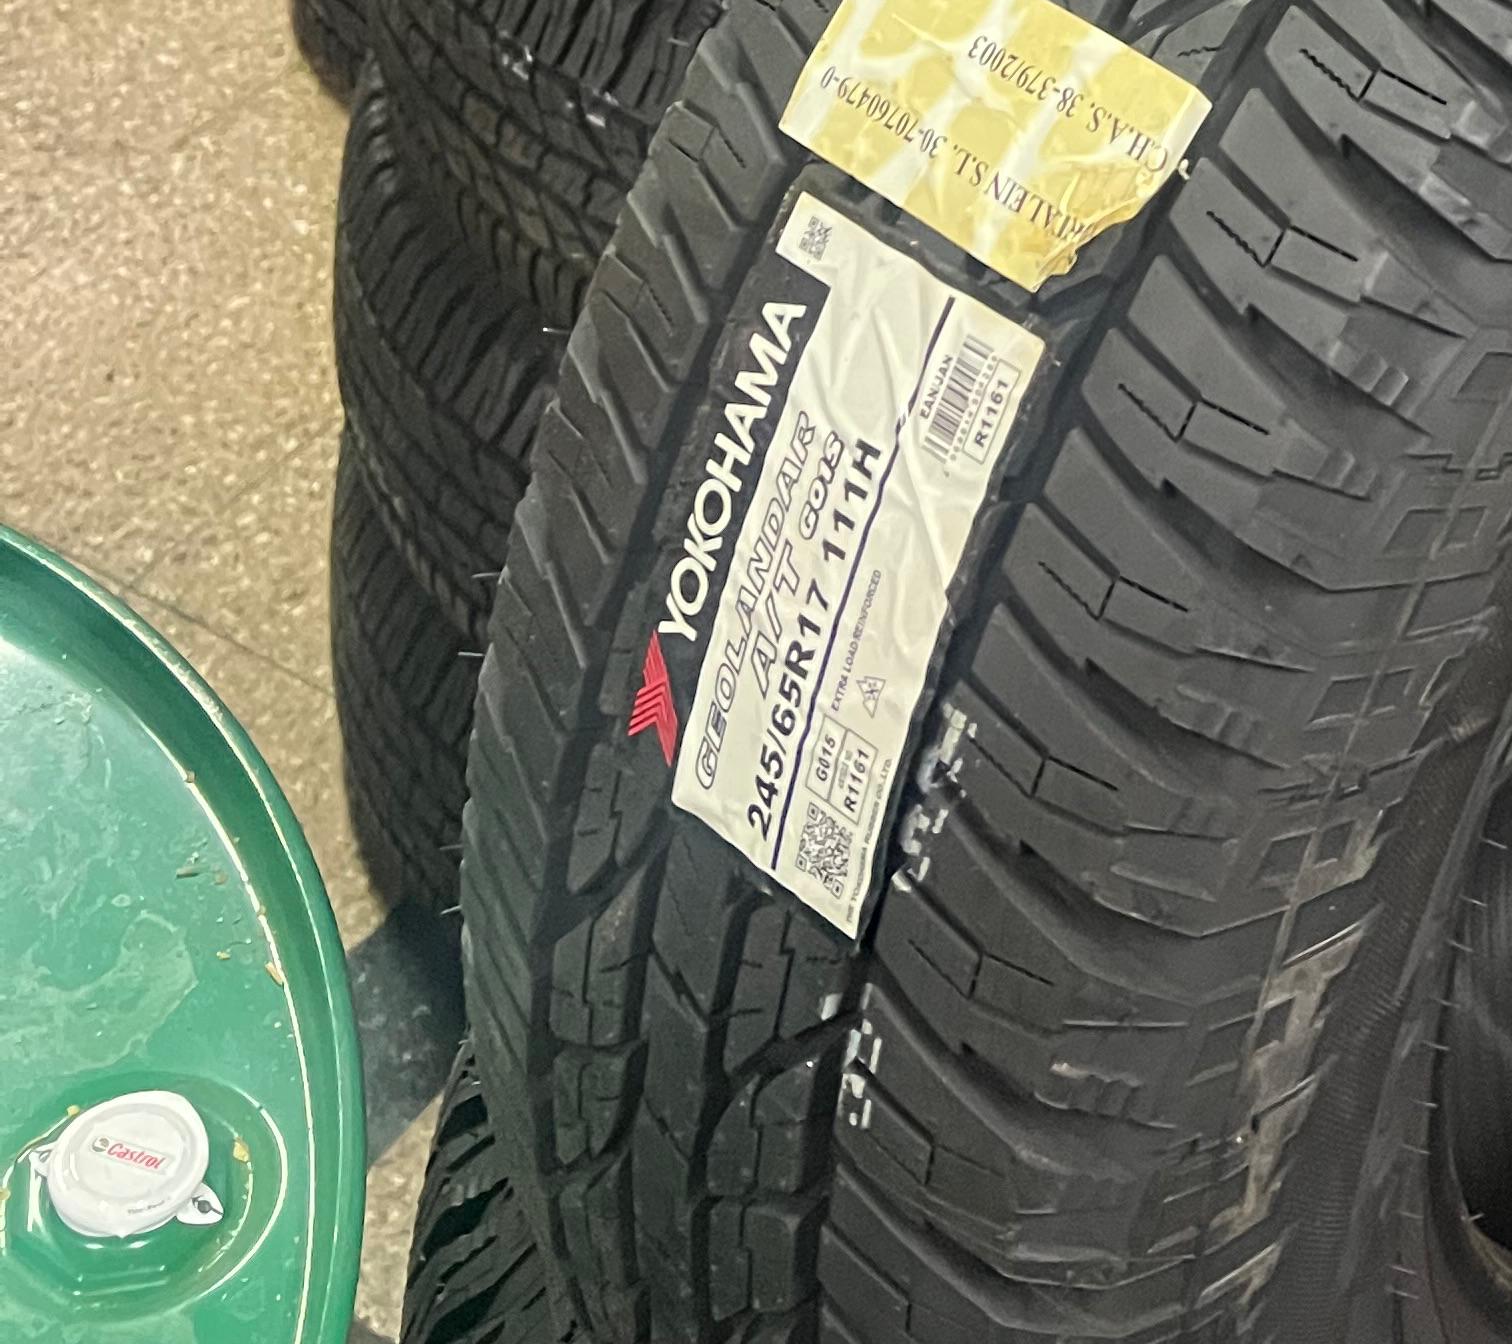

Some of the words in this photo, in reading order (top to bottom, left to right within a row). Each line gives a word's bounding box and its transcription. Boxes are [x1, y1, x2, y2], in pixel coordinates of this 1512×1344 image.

[819, 64, 949, 161] 30-70760479-0
[967, 34, 1085, 115] 38-379/2003
[953, 144, 991, 188] S.L.
[975, 378, 1009, 449] R1161
[658, 301, 808, 642] YOKOHAMA
[695, 410, 817, 790] GEOLANDAR
[750, 538, 801, 700] A/T
[747, 578, 831, 842] 245/65R17
[821, 438, 881, 564] 111H
[831, 674, 849, 712] EXTRA
[843, 641, 859, 674] LOAD
[816, 734, 837, 782] G015
[844, 748, 870, 814] R1161
[107, 1143, 166, 1169] Castrol
